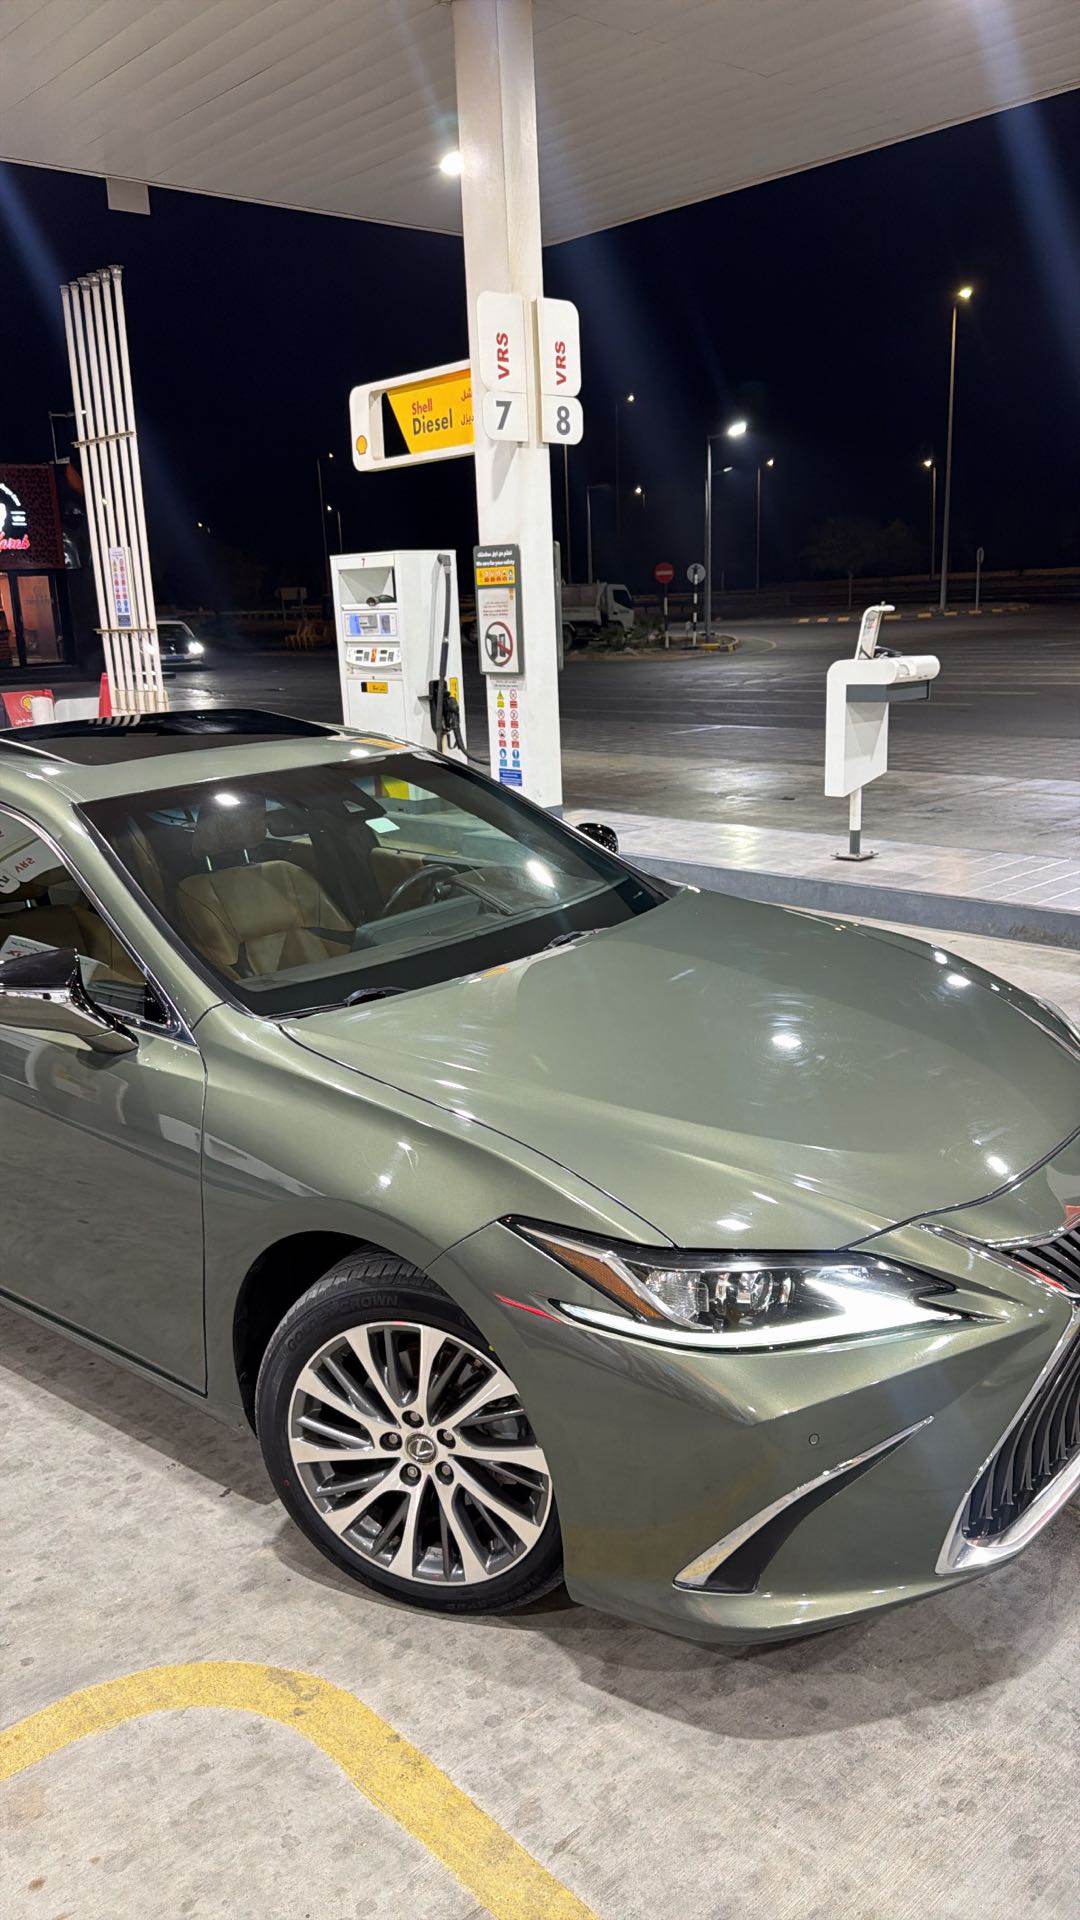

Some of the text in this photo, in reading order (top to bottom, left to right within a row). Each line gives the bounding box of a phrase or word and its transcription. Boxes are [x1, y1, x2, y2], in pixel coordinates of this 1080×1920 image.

[496, 332, 510, 379] VRS
[555, 341, 566, 385] VRS
[411, 398, 433, 415] Shell
[495, 401, 512, 430] 7
[556, 406, 571, 436] 8
[412, 407, 453, 436] Diesel
[361, 557, 366, 568] 7
[339, 1294, 399, 1313] CROWN
